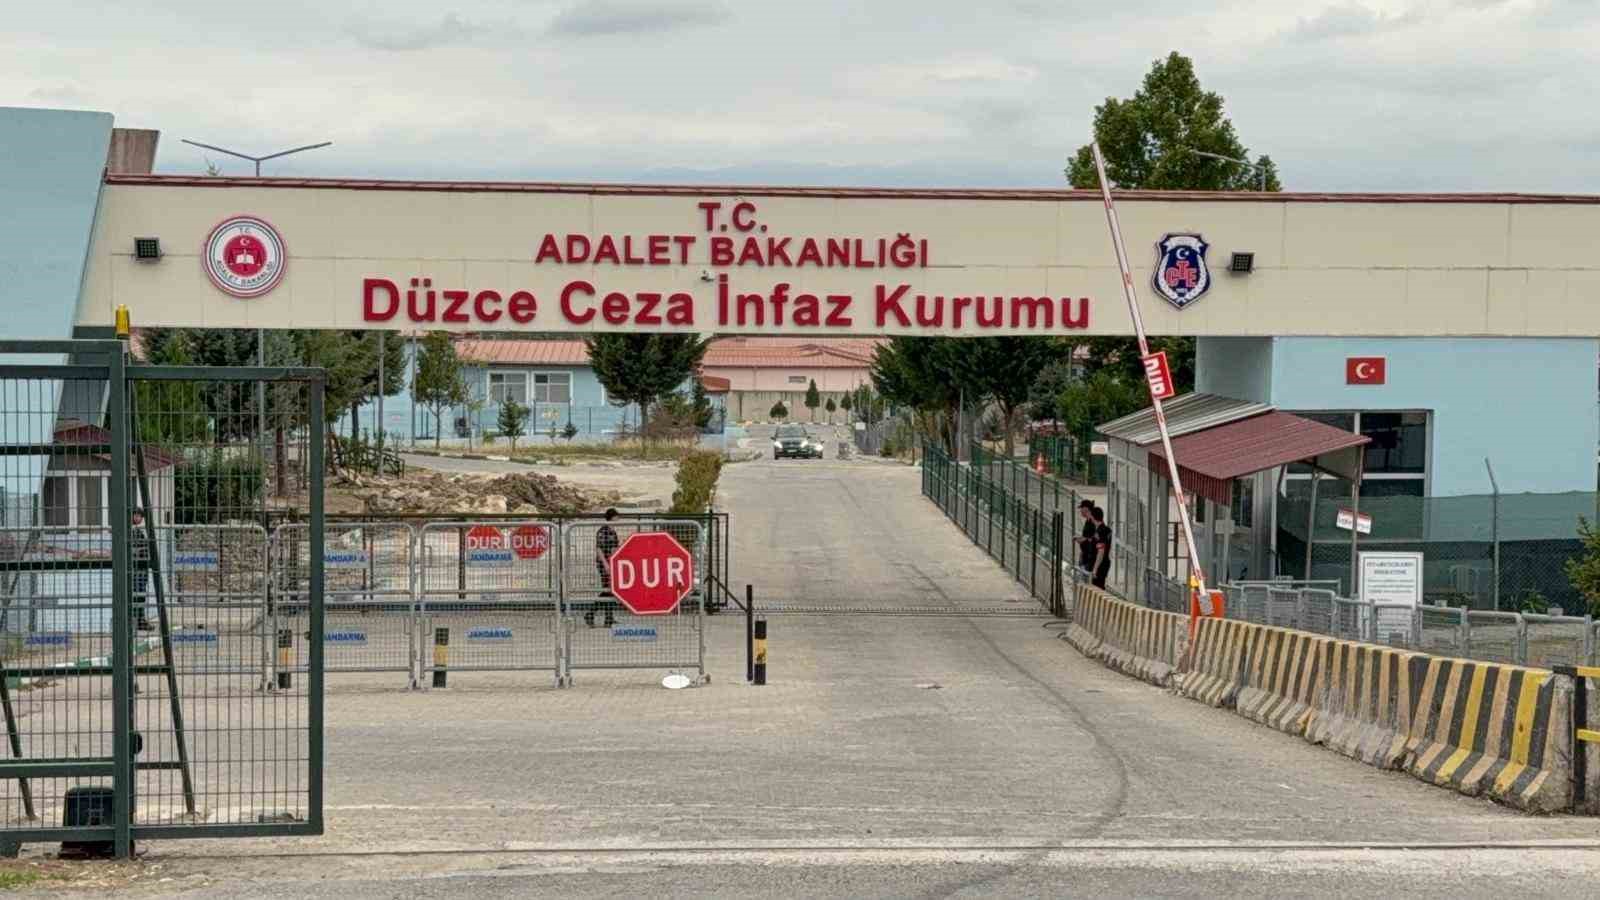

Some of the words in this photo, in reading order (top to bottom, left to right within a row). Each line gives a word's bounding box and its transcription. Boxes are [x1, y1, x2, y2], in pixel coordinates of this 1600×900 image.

[699, 202, 768, 232] T.C.
[535, 233, 697, 265] ADALET
[710, 232, 929, 269] BAKANLIĞI
[363, 278, 538, 323] Düzce
[559, 280, 695, 326] Ceza
[718, 273, 853, 327] İnfaz
[875, 284, 1090, 329] Kurumu
[466, 535, 501, 549] DUR
[512, 534, 547, 549] DUR
[469, 553, 513, 561] JANDARMA
[617, 557, 685, 590] DUR
[467, 629, 513, 638] JANDARMA
[614, 628, 656, 636] JANDARMA
